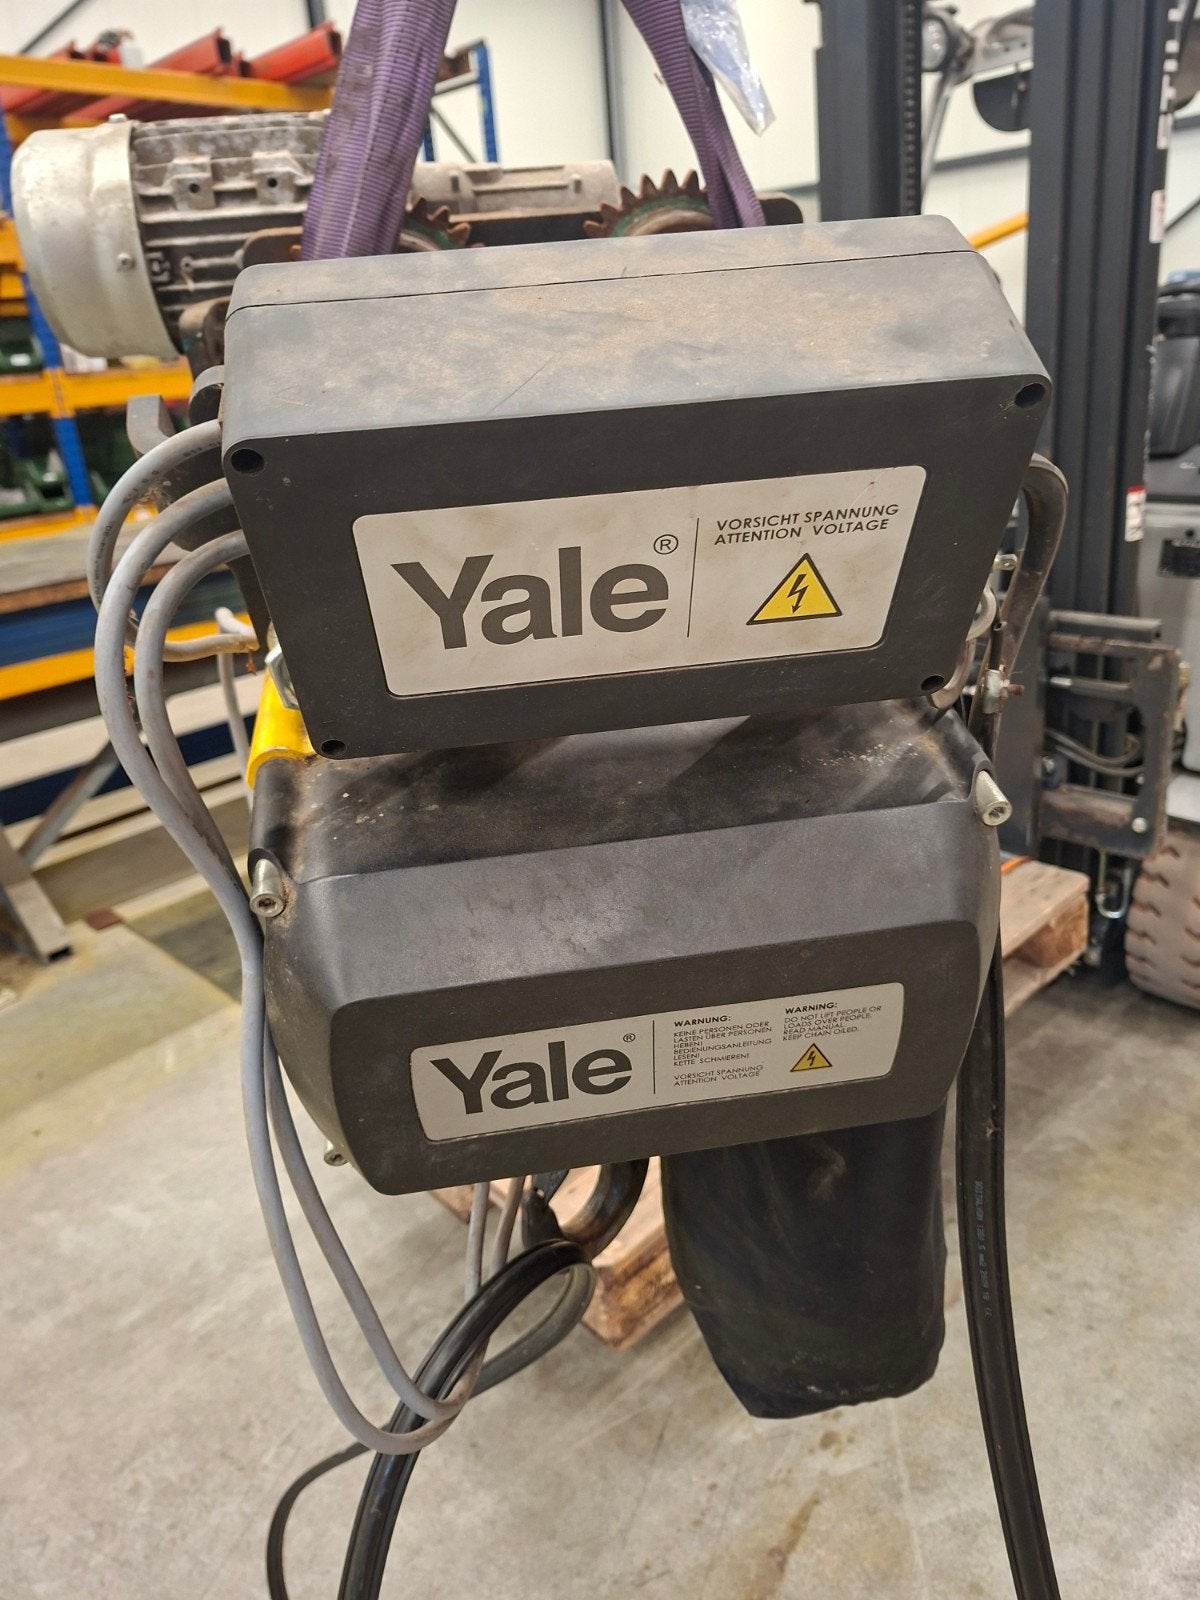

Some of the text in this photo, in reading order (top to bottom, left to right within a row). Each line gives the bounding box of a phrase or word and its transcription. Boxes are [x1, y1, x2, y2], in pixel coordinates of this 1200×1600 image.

[717, 504, 899, 531] VORSICHT SPANNUNG
[714, 518, 889, 545] ATTENTION VOLTAGE
[390, 546, 669, 649] Yale
[785, 1003, 838, 1014] WARNING:
[820, 1011, 835, 1019] LIFT
[836, 1007, 867, 1016] PEOPLE
[673, 1015, 732, 1027] WARNUNG:
[698, 1025, 743, 1034] PERSONEN
[744, 1020, 770, 1029] ODER
[783, 1021, 812, 1029] LOADS
[814, 1018, 838, 1026] OVER
[673, 1035, 703, 1043] LASTEN
[728, 1026, 772, 1036] PERSONEN
[782, 1033, 802, 1041] KEEP
[804, 1030, 832, 1039] CHAIN
[783, 1027, 806, 1035] READ
[673, 1038, 772, 1055] BEDIENUNGSANLEITUNG
[673, 1053, 700, 1061] LESEN!
[430, 1041, 632, 1114] Yale
[673, 1064, 764, 1080] VORSICHT SPANNUNG
[673, 1071, 760, 1086] ATTENTION VOLTAGE
